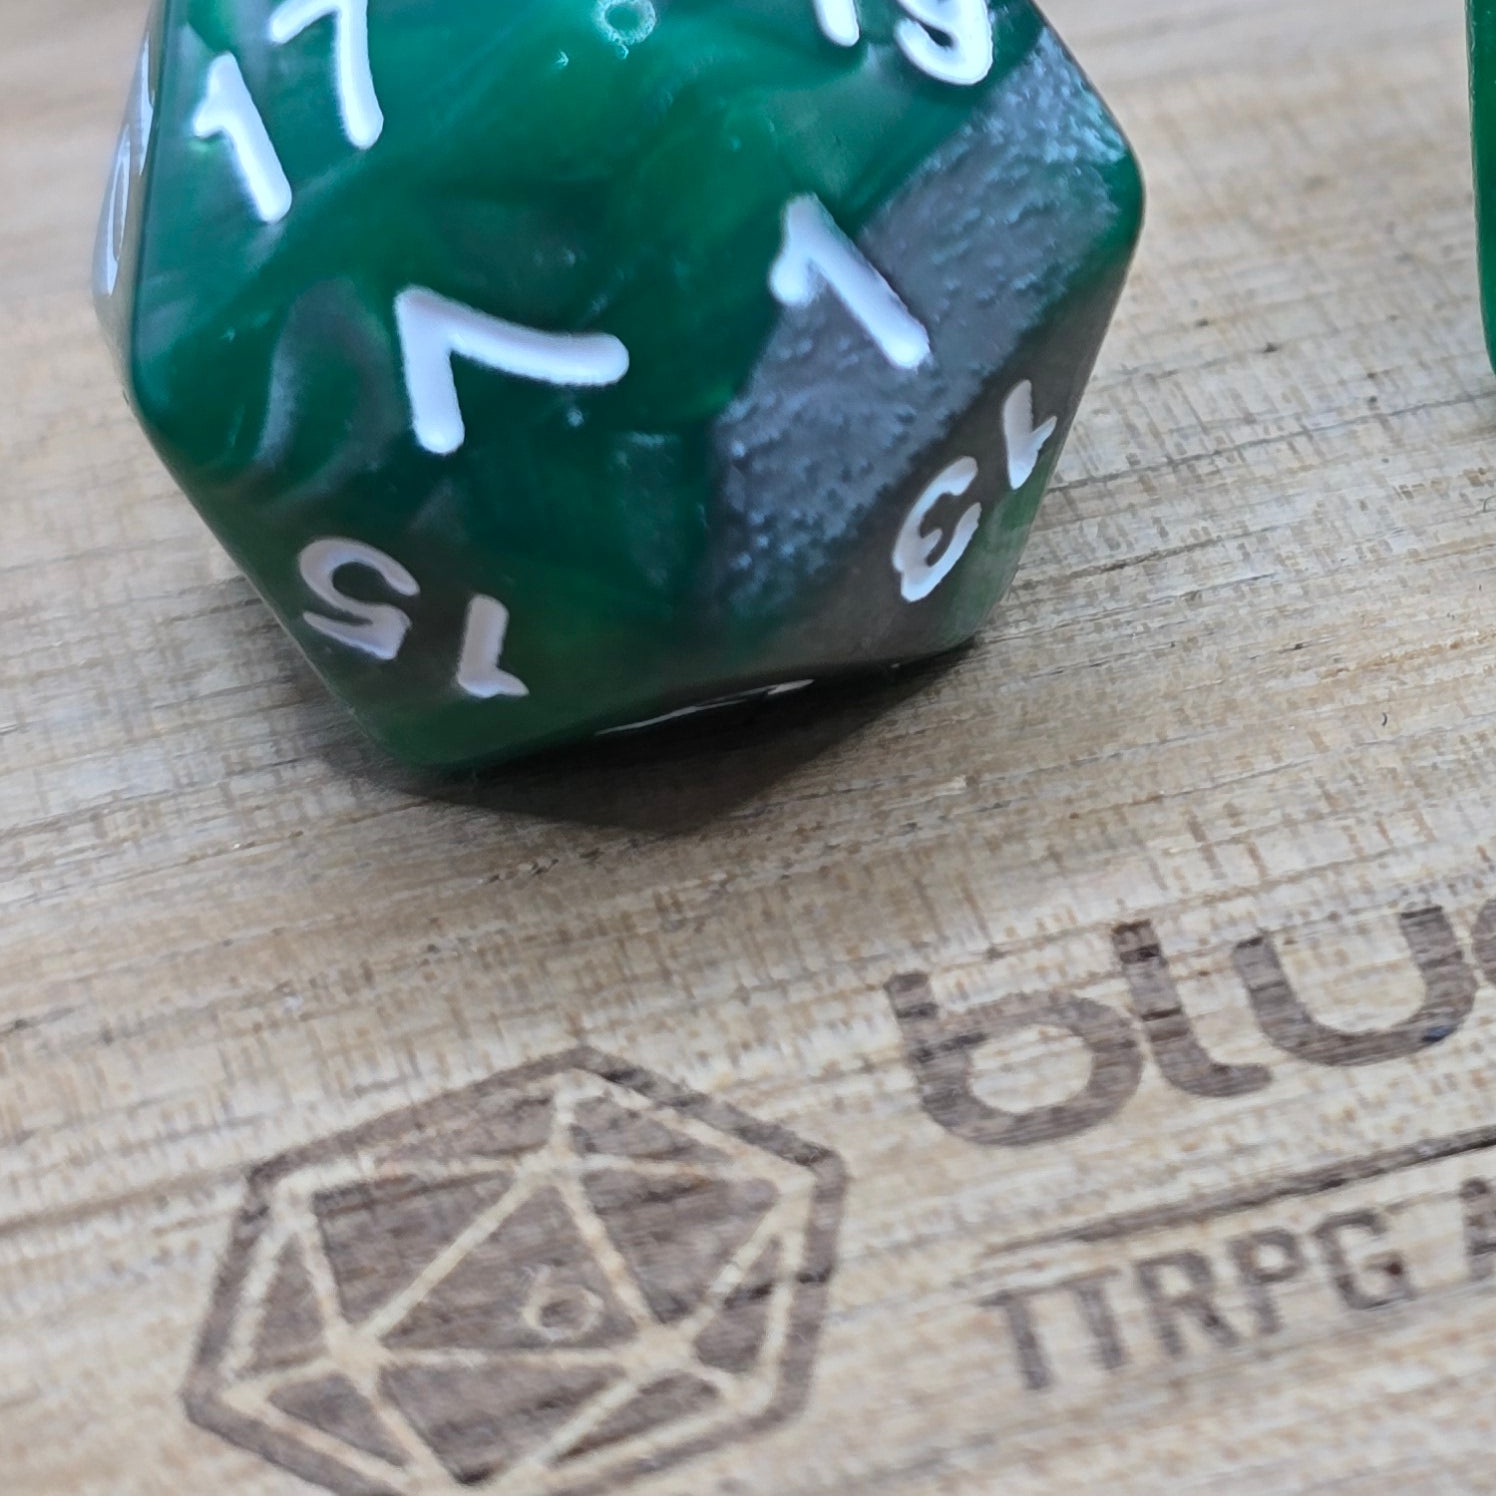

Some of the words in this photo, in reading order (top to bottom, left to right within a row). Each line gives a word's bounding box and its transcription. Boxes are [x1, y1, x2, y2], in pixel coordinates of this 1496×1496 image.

[395, 284, 629, 456] 7
[770, 194, 930, 370] 1
[892, 378, 1058, 603] 13
[296, 536, 530, 700] 15
[980, 1208, 1418, 1392] TTRPG
